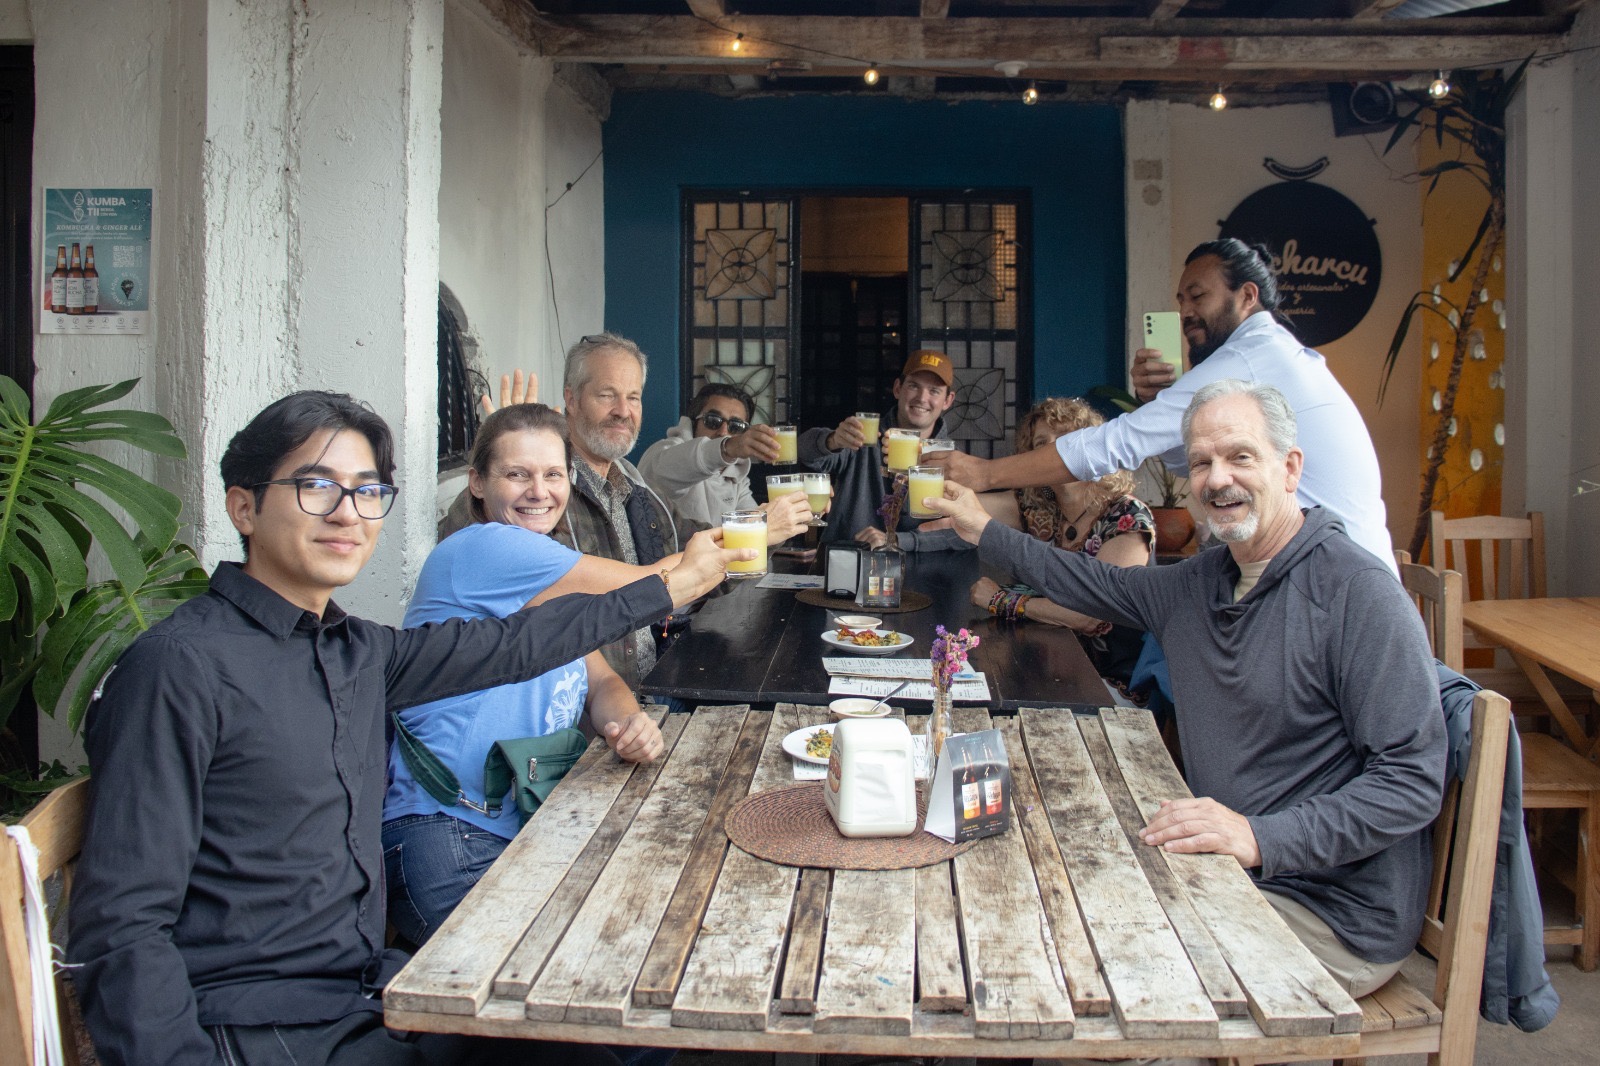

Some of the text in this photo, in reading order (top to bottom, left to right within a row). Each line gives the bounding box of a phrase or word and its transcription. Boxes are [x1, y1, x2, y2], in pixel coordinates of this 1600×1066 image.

[87, 197, 126, 206] KUMBA
[87, 207, 100, 217] TII
[920, 355, 943, 367] CAT
